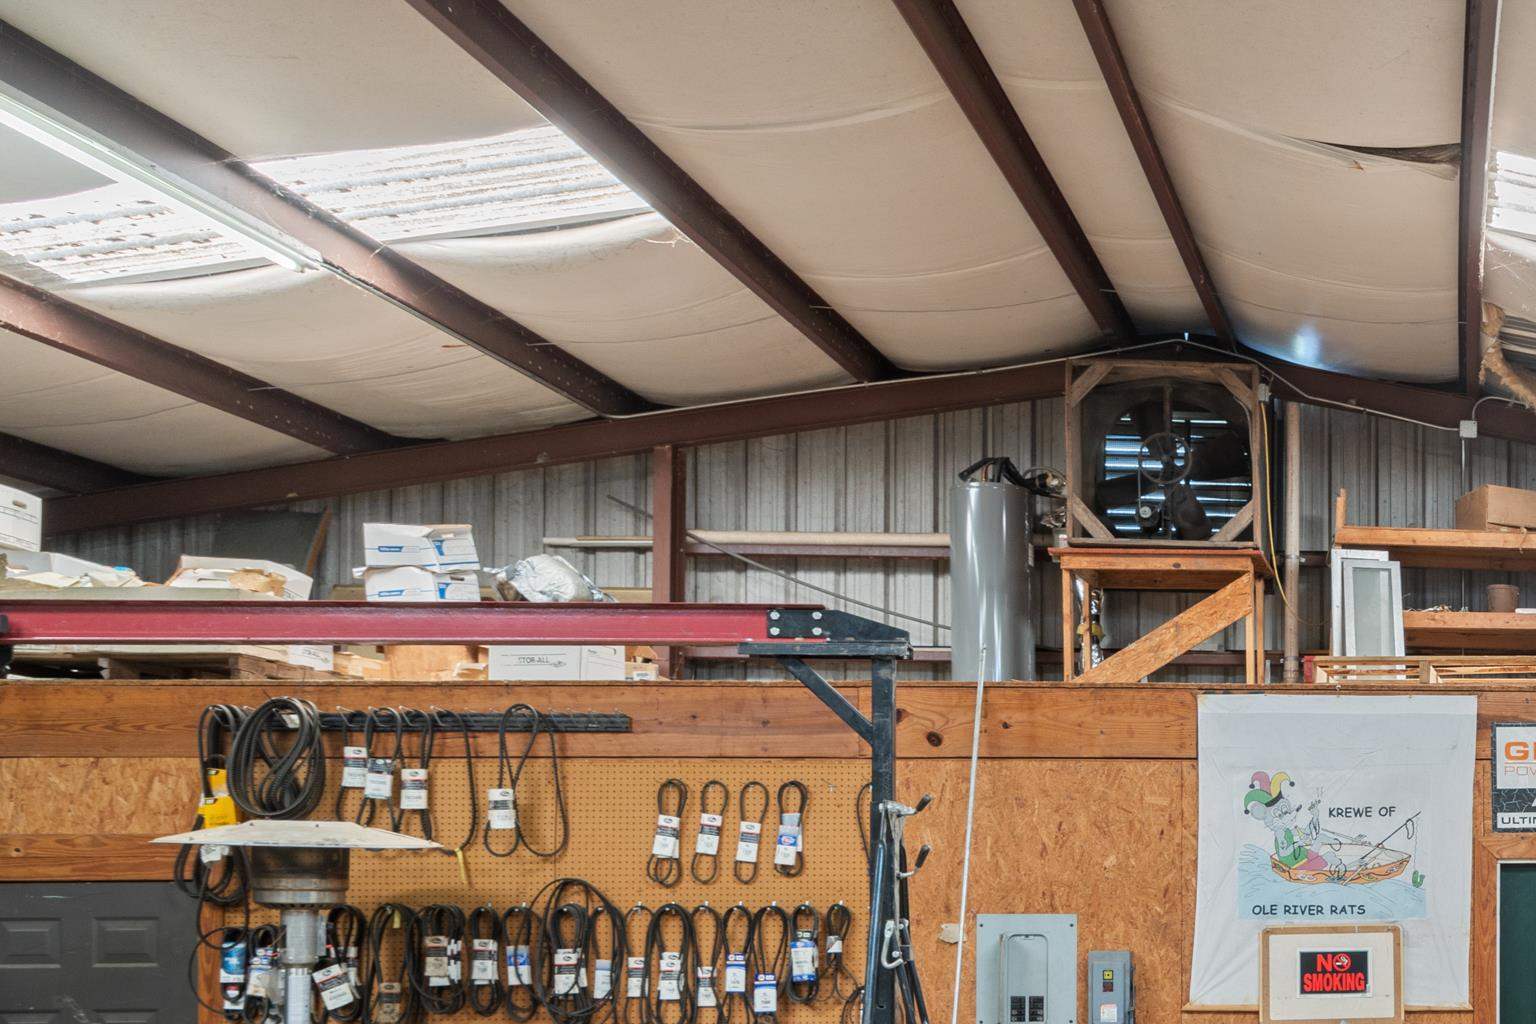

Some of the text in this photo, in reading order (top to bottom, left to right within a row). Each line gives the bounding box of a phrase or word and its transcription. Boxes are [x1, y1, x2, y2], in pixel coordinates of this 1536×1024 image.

[1328, 806, 1397, 818] KREWE OF
[1251, 904, 1366, 915] OLE RIVER RATS
[1303, 972, 1367, 992] SMOKING
